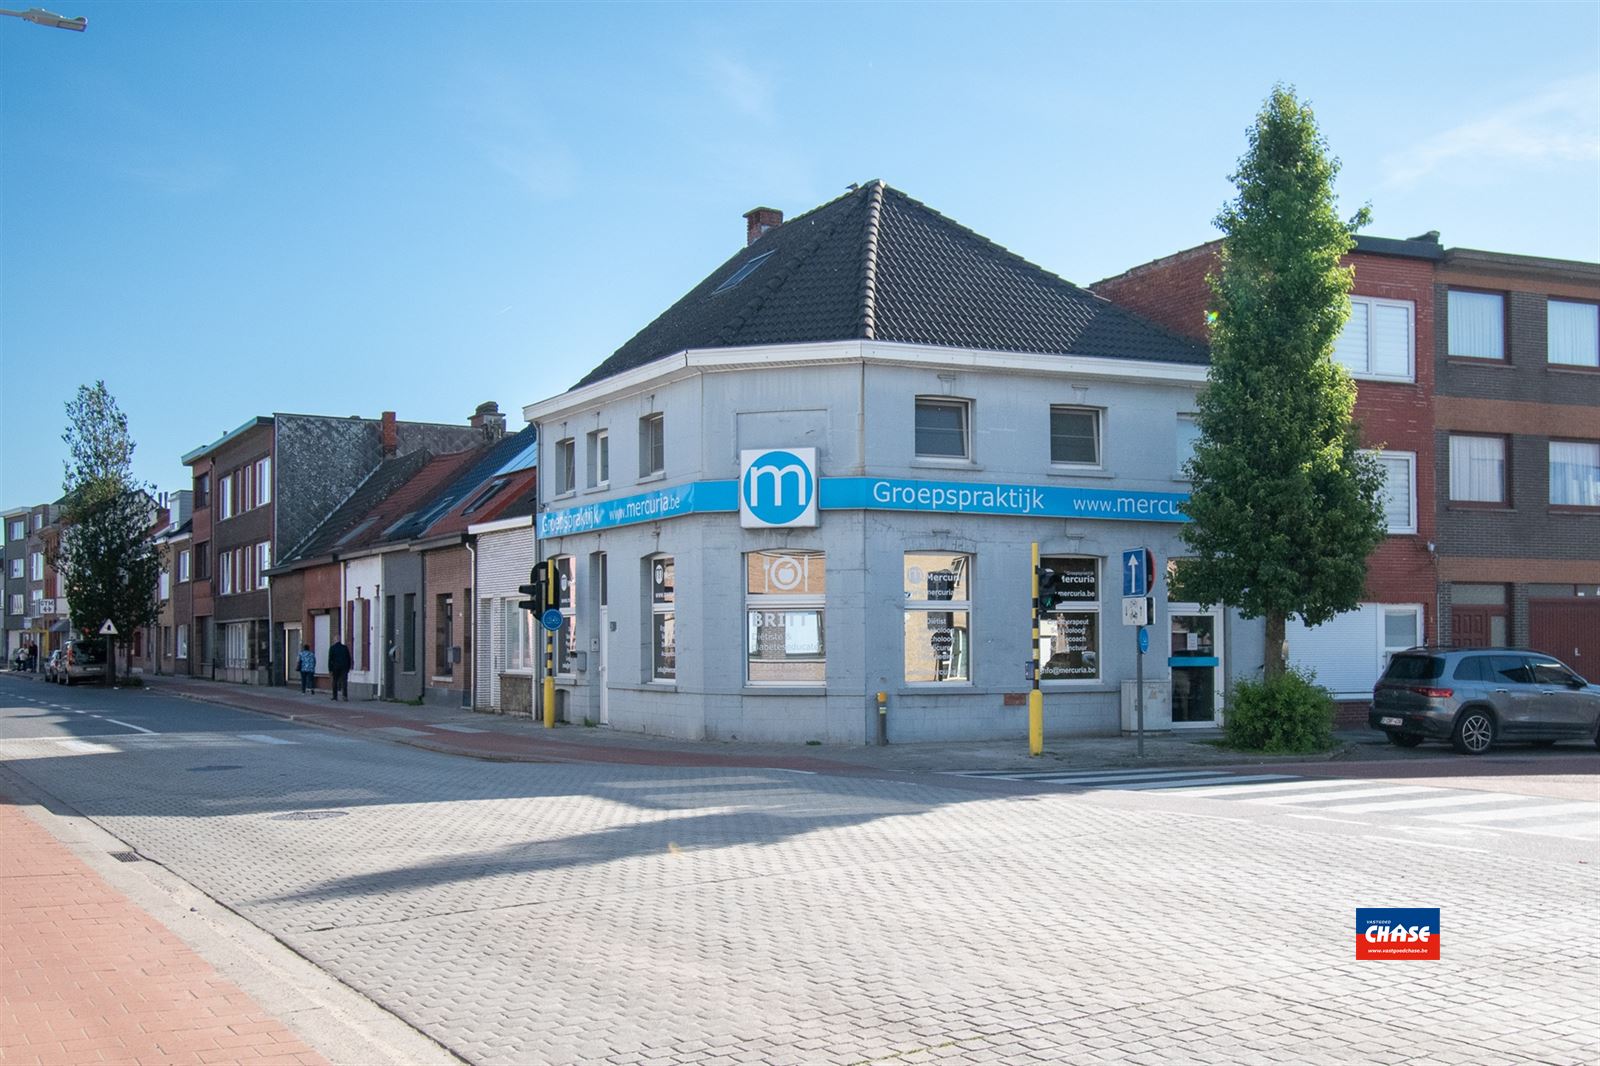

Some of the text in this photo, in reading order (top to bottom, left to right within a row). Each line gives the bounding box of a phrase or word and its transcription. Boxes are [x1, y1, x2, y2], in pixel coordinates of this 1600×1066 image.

[609, 493, 680, 521] www.mercuria.be
[873, 481, 1045, 513] Groepspraktijk
[1073, 497, 1180, 515] www.mercu
